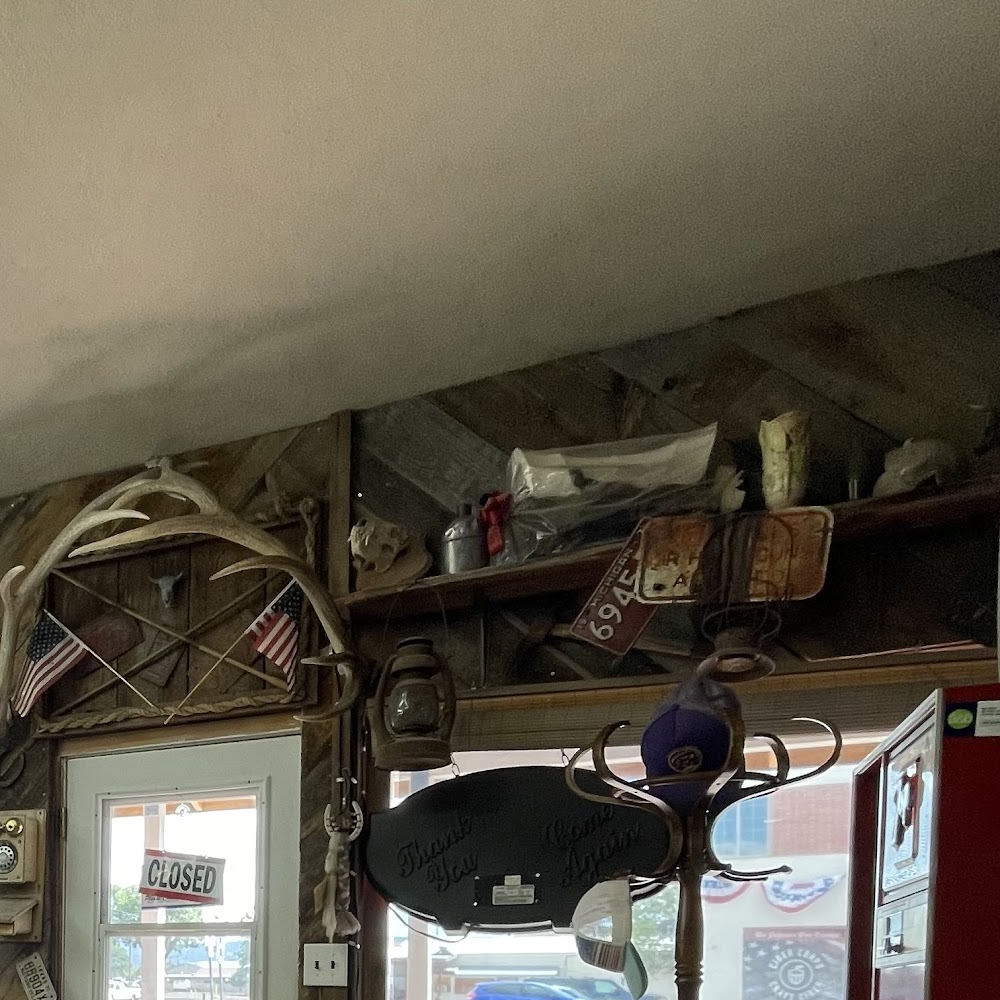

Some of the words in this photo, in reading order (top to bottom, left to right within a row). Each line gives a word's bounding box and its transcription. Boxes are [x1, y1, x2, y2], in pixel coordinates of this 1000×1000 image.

[590, 548, 635, 607] MICHIGAN
[397, 816, 474, 878] Thank
[147, 859, 217, 894] CLOSED
[427, 852, 479, 893] You
